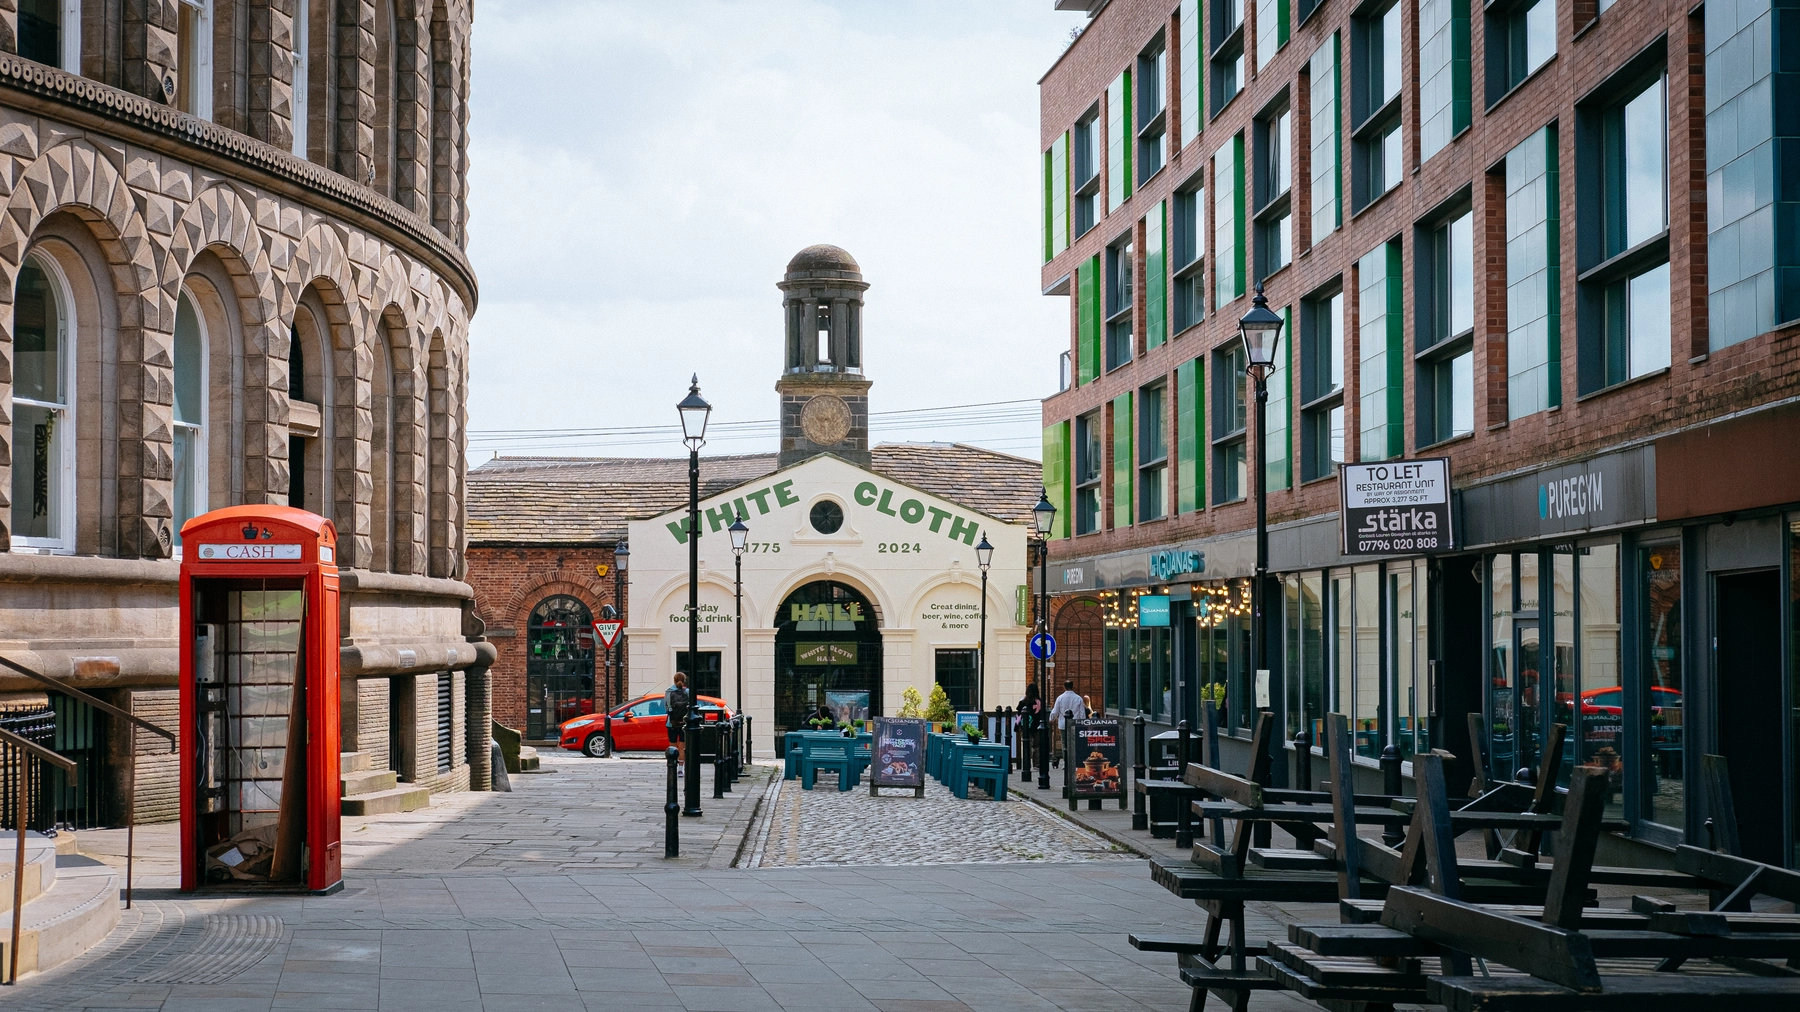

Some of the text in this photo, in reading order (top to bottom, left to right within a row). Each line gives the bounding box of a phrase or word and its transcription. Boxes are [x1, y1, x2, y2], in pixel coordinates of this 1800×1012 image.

[1366, 465, 1423, 481] TO LET
[1356, 480, 1435, 491] RESTAURANT UNIT
[1548, 472, 1602, 518] PUREGYM
[666, 479, 979, 546] WHITE CLOTH
[743, 543, 780, 553] 1775
[878, 543, 922, 553] 2024
[1359, 538, 1437, 551] 07796 020 808
[226, 546, 274, 558] CASH
[791, 604, 864, 621] HALL
[800, 645, 853, 659] WHITE CLOTH
